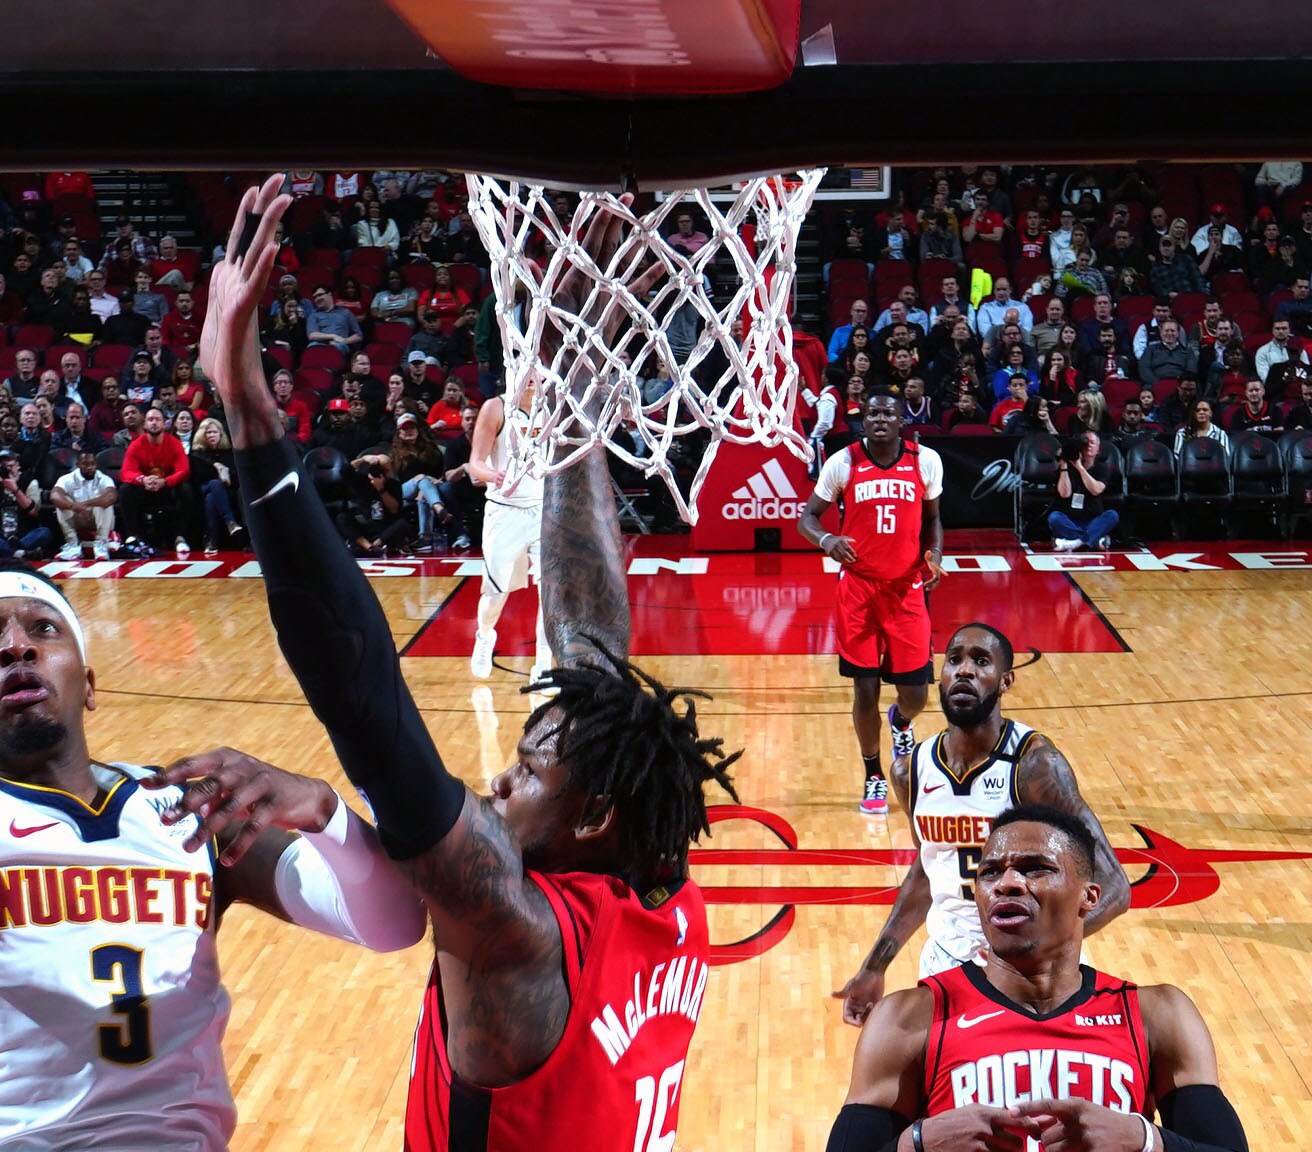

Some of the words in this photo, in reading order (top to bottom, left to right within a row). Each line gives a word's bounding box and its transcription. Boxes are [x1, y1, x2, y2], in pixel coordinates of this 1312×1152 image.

[854, 479, 916, 503] ROCKETS
[876, 505, 896, 534] 15
[983, 778, 1004, 789] WU
[89, 941, 155, 1067] 3
[950, 1049, 1134, 1115] ROCKETS
